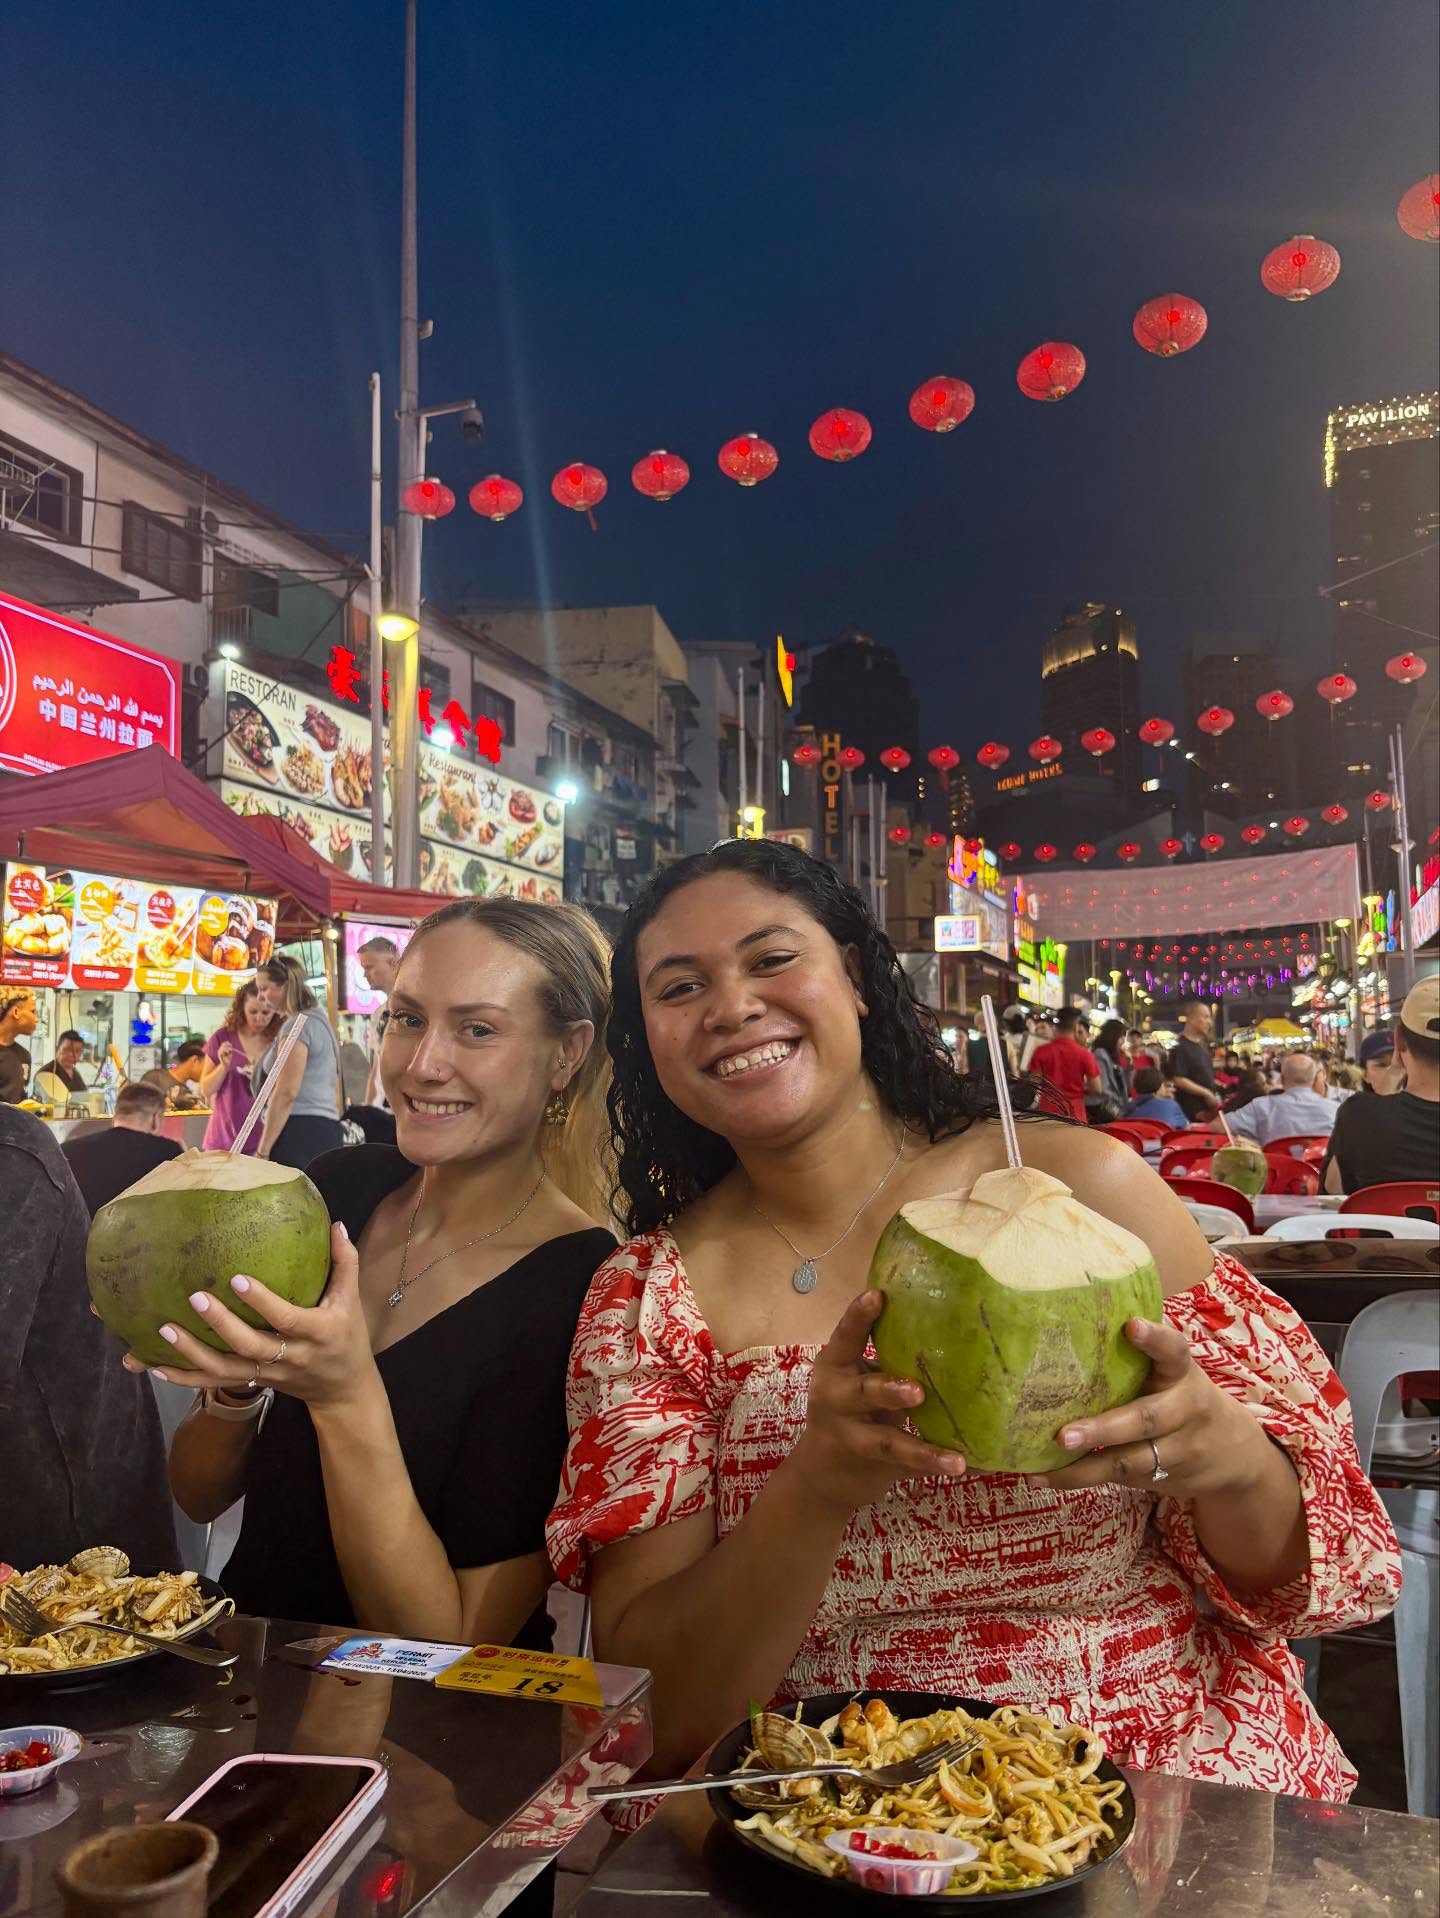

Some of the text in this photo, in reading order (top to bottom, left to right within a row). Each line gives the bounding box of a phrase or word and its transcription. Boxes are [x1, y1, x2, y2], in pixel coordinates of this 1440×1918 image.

[1346, 404, 1430, 427] PAVILION
[230, 669, 297, 712] RESTORAN
[38, 698, 154, 749] 中国兰州拉面
[822, 733, 841, 860] HOTEL
[395, 1649, 436, 1659] PERMIT
[507, 1677, 565, 1695] 18
